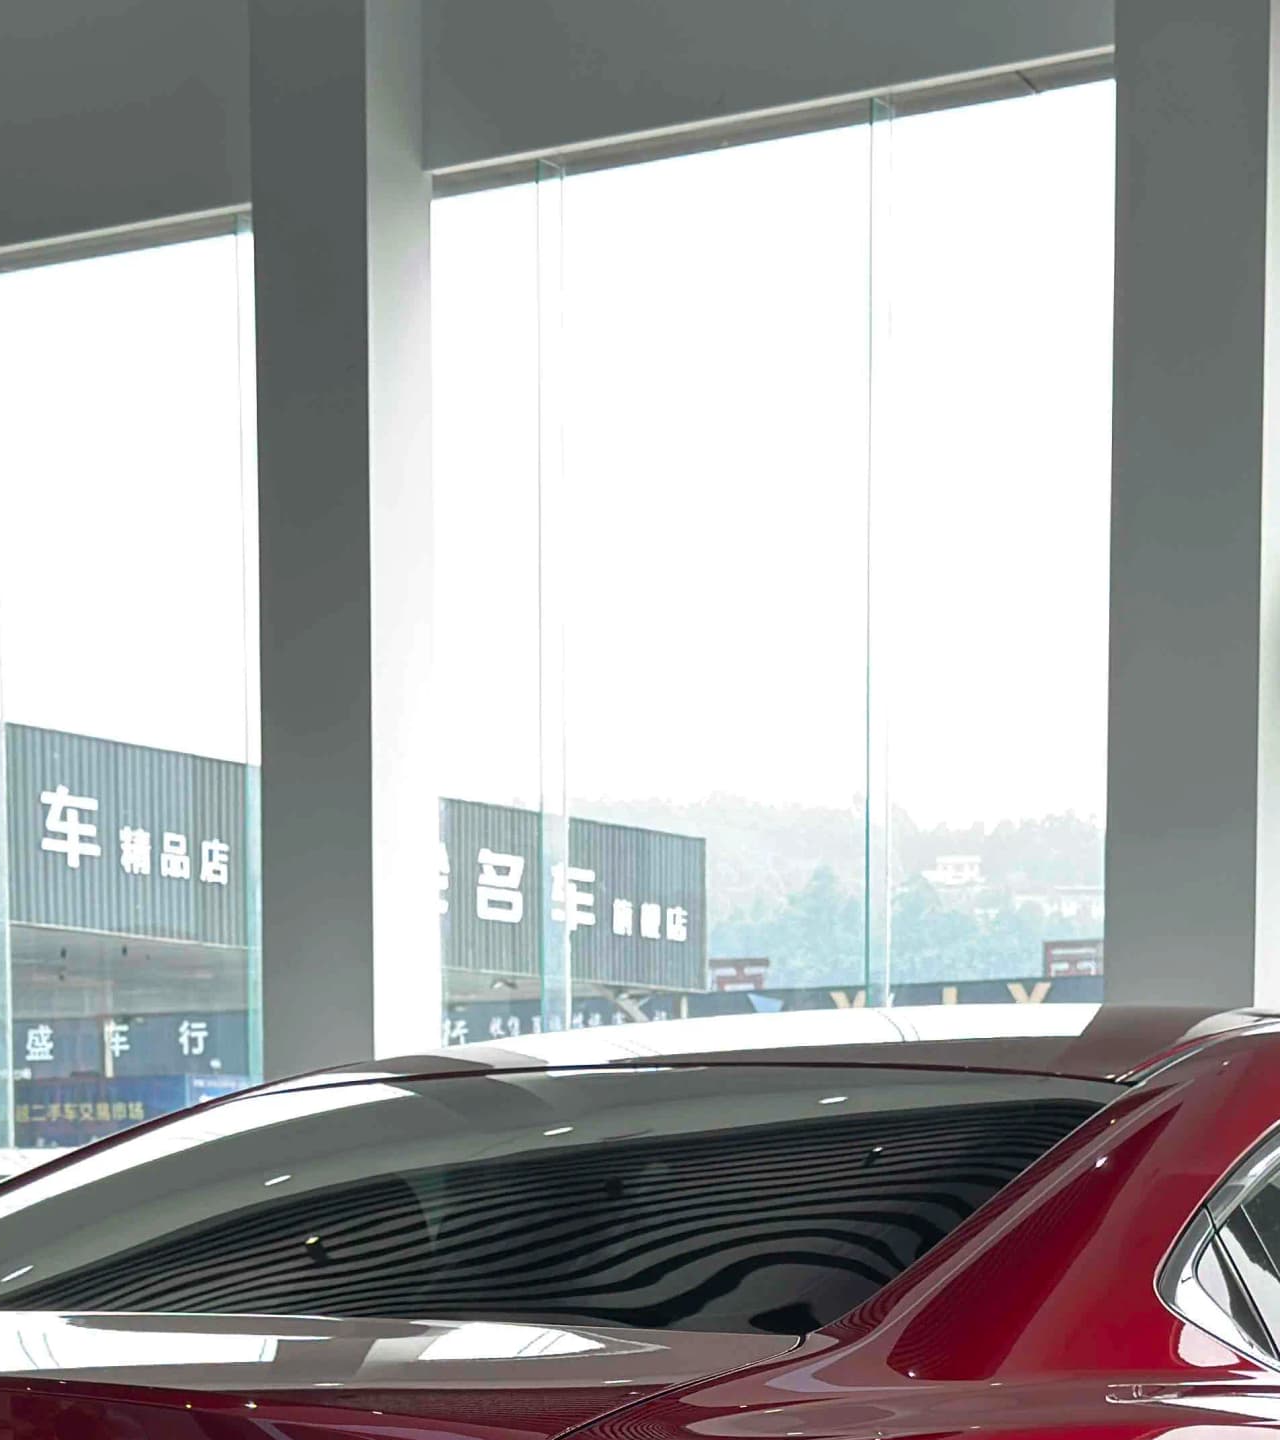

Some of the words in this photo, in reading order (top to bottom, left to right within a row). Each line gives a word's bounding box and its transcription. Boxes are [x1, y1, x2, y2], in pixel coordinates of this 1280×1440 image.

[119, 824, 231, 886] 精品店
[439, 841, 597, 931] 名车
